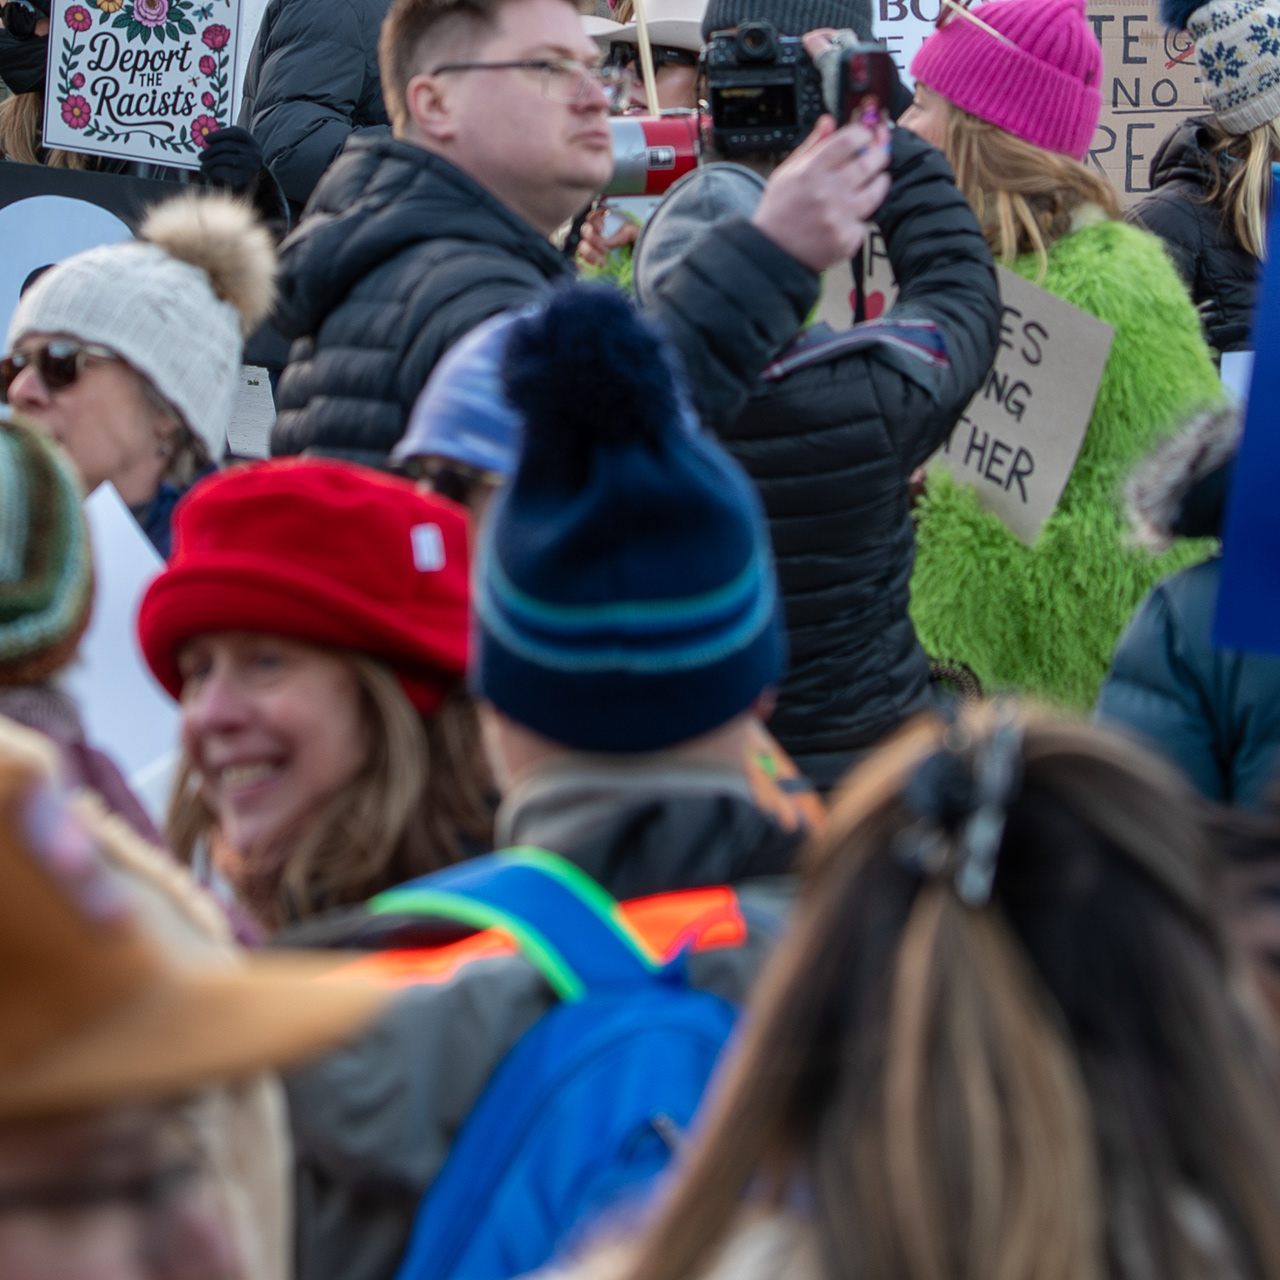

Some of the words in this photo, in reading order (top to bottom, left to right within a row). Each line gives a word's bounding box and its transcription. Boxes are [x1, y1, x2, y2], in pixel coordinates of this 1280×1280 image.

[87, 32, 193, 84] Deport
[139, 72, 162, 87] THE
[1112, 76, 1208, 108] NO
[90, 76, 197, 131] Racists
